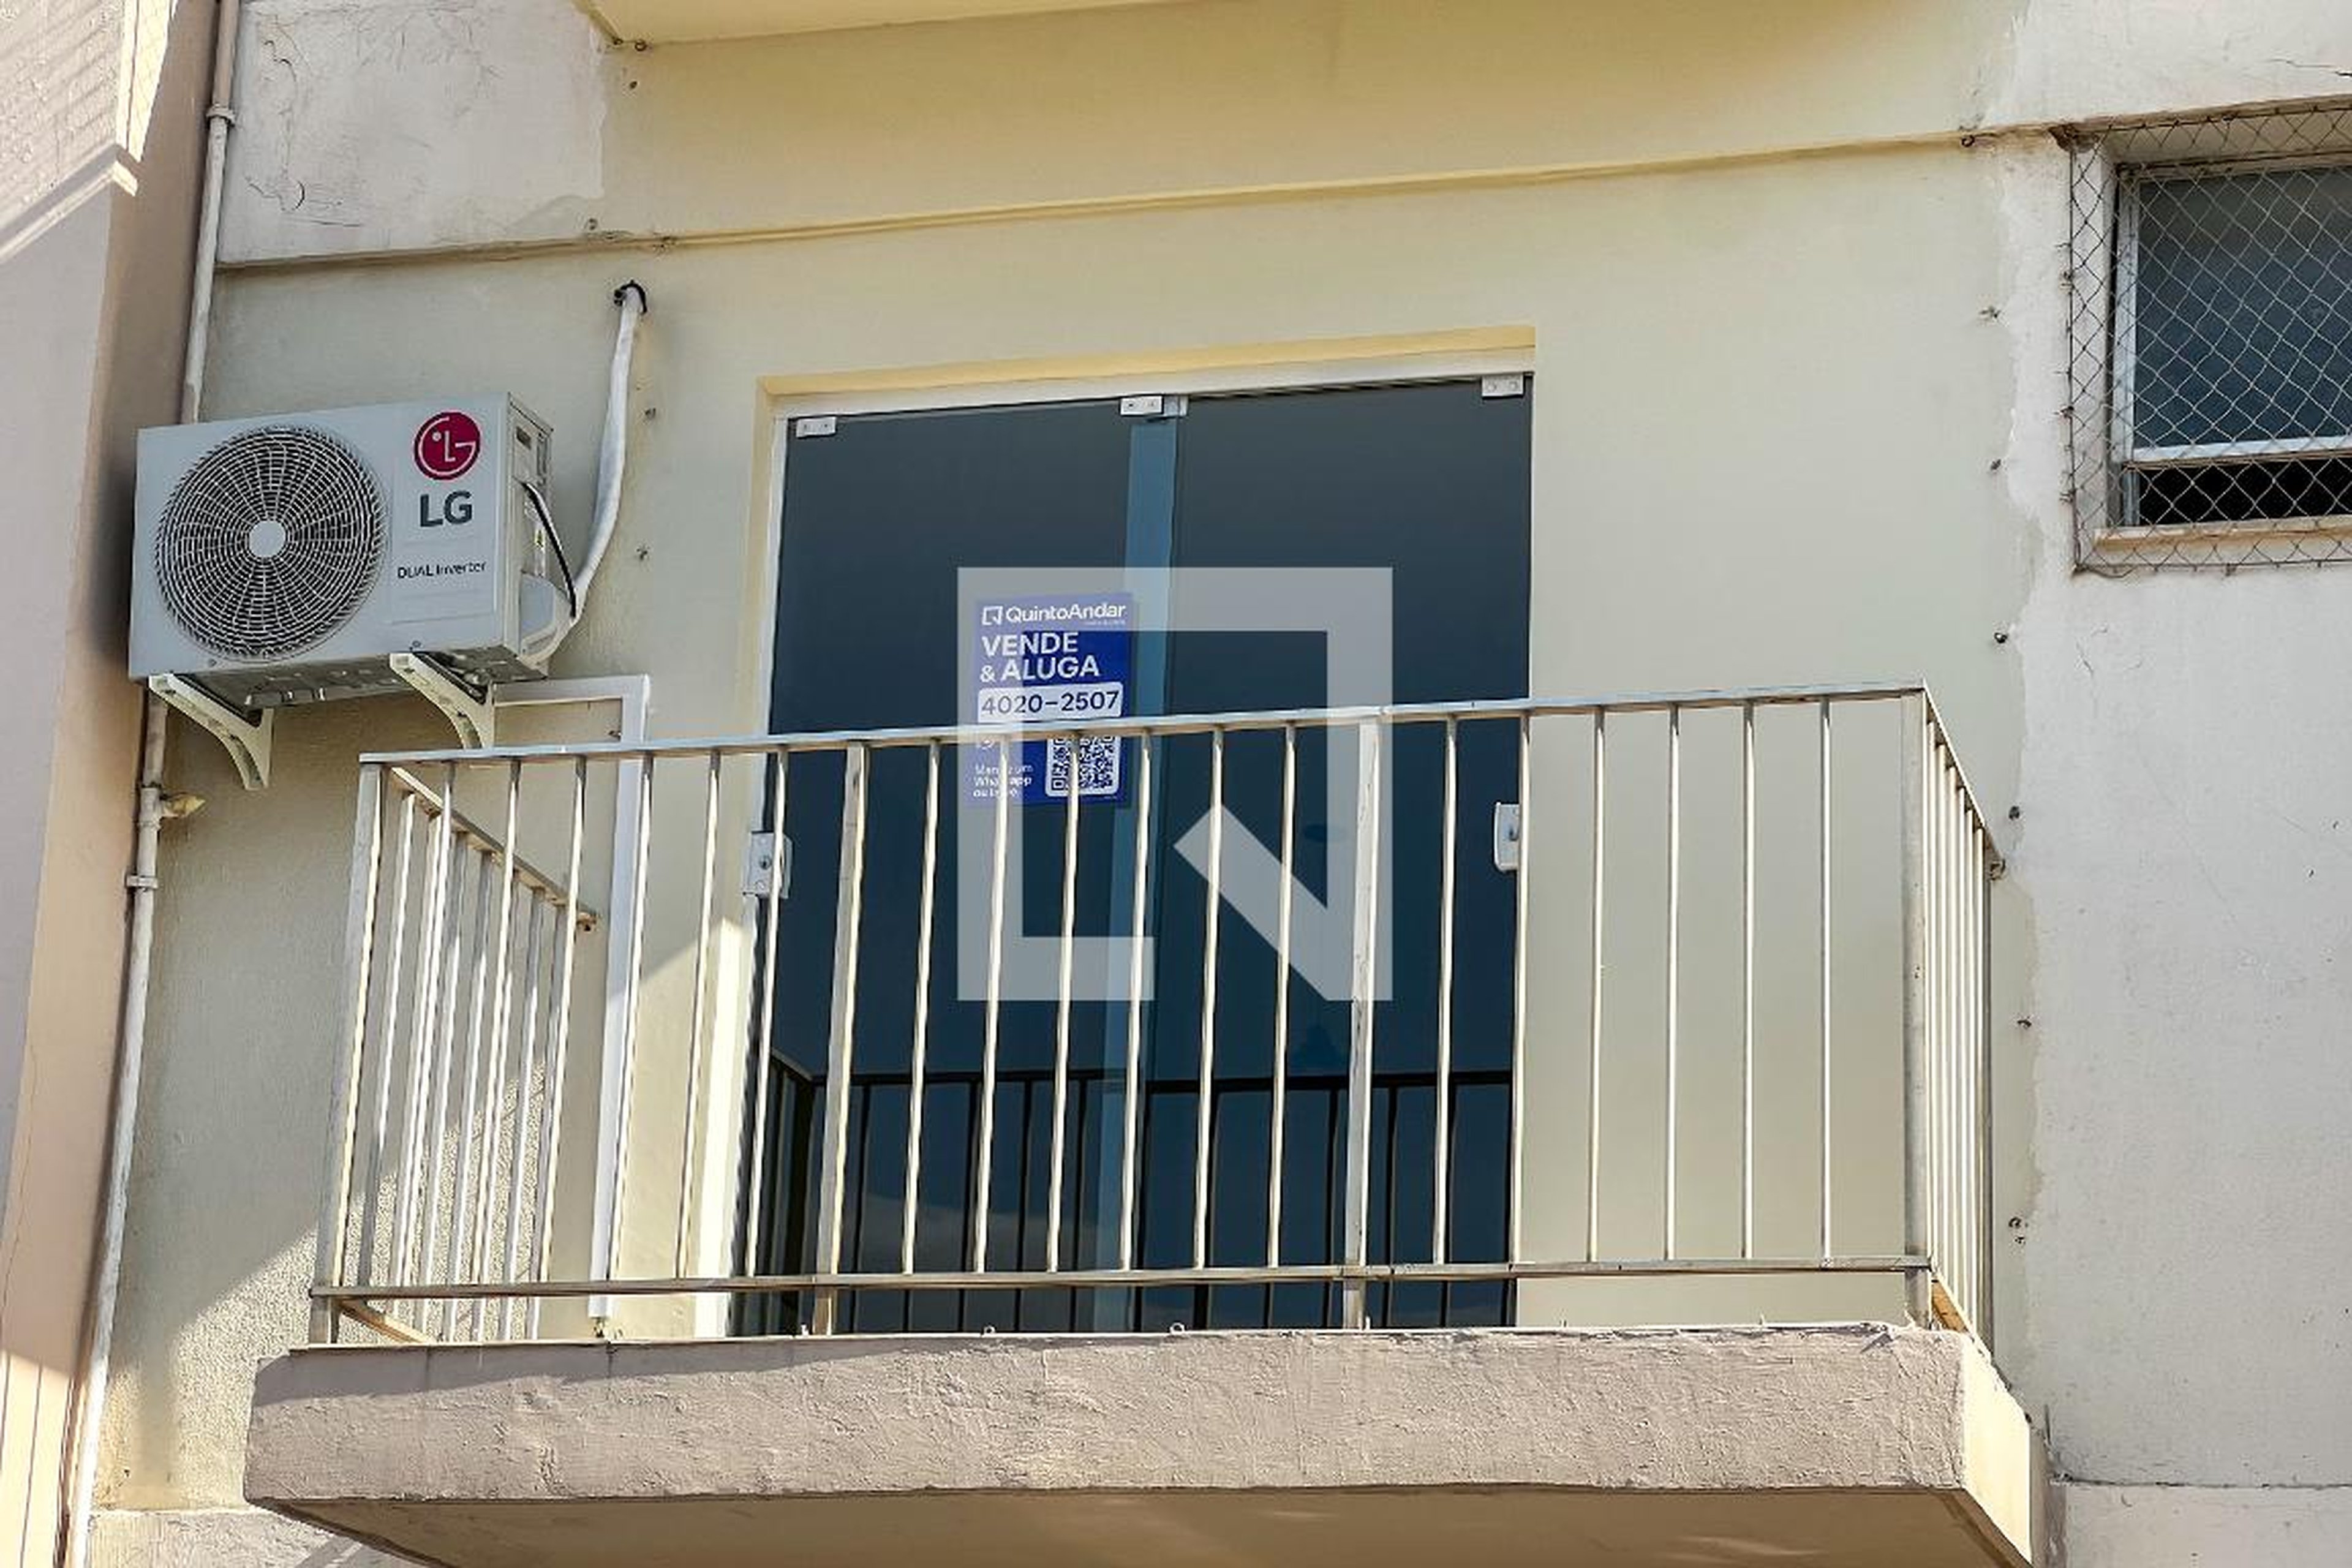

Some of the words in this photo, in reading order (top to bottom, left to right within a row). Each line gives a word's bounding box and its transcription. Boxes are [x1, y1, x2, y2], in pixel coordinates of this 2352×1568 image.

[420, 490, 472, 527] LG
[398, 564, 434, 579] DUAL
[436, 561, 486, 575] Inverter
[1005, 601, 1126, 623] QuintoAndar
[982, 631, 1078, 657] VENDE
[980, 665, 995, 682] &
[1001, 654, 1100, 682] ALUGA
[982, 690, 1120, 715] 4020-2507
